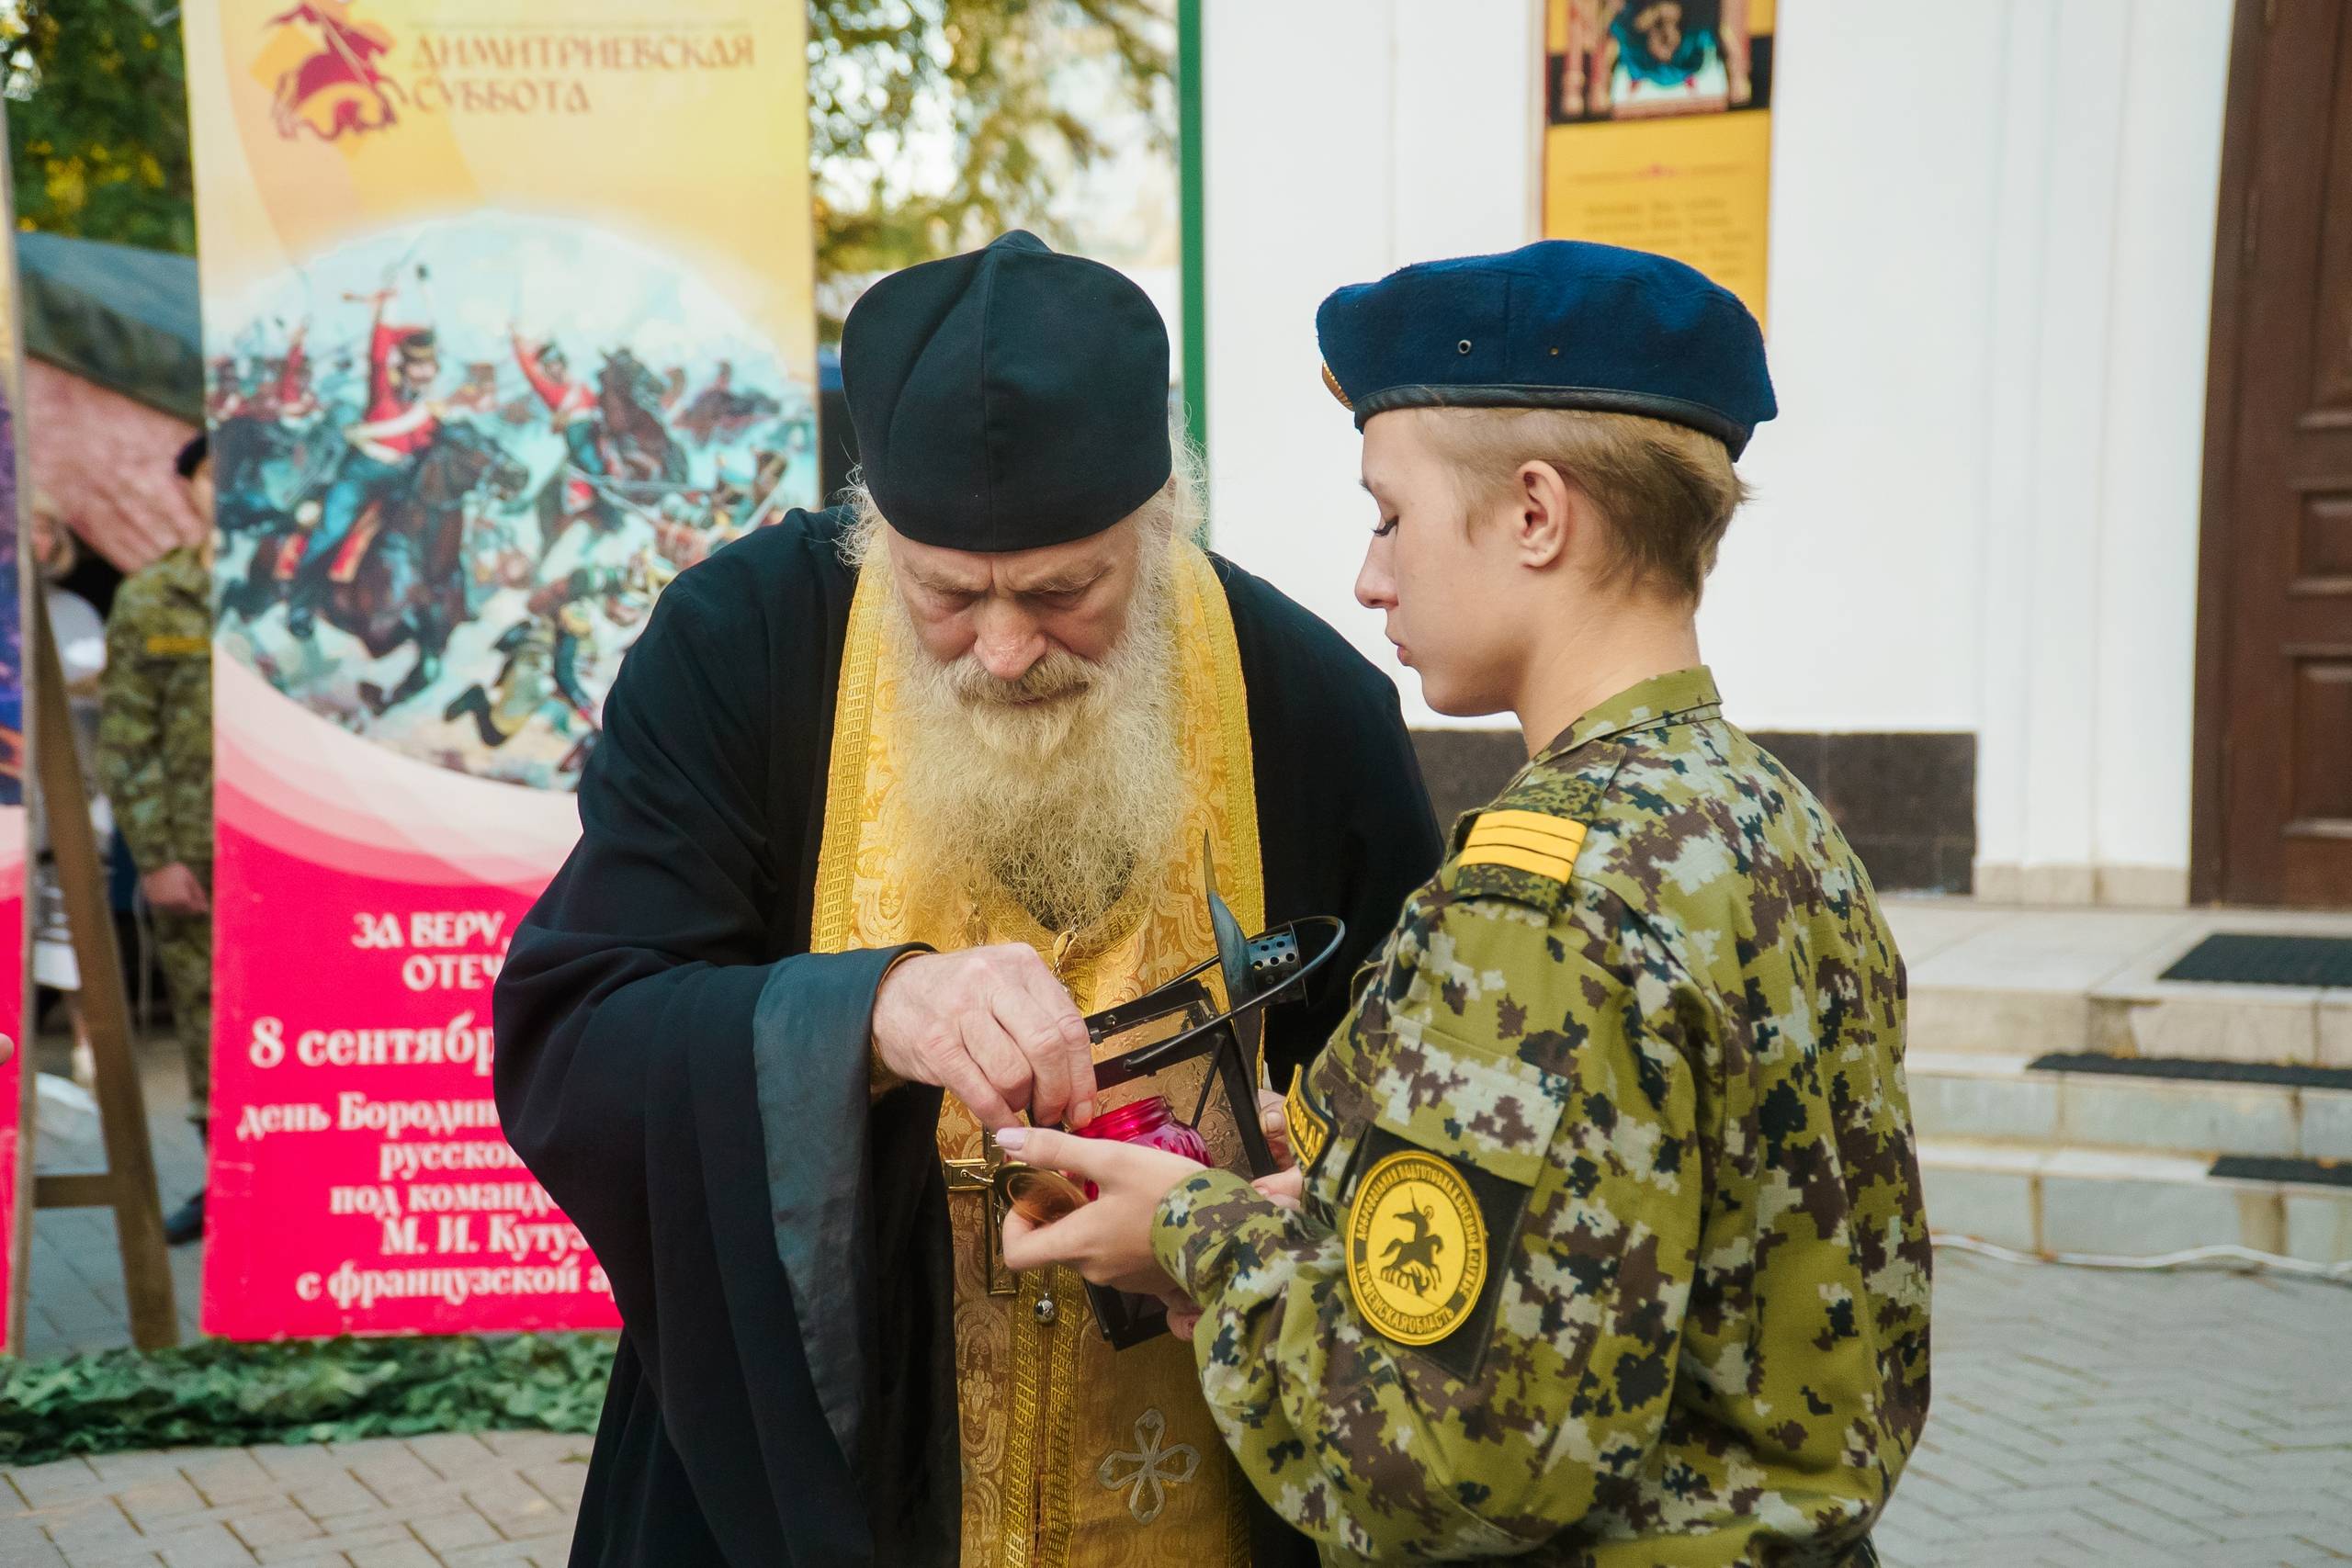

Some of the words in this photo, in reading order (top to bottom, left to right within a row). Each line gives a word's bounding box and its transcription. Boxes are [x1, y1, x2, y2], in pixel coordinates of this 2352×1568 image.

[413, 33, 754, 71] ДИМИТРИЕВСКАЯ
[413, 75, 593, 114] СУББОТА
[351, 911, 404, 949] ЗА
[249, 1016, 285, 1068] 8
[236, 1104, 332, 1141] день
[329, 1186, 401, 1220] под
[381, 1216, 428, 1255] М.
[436, 1215, 481, 1253] И.
[296, 1271, 322, 1301] с
[327, 1253, 582, 1310] французской
[1357, 1261, 1408, 1332] ТЮМЕНСКАЯ
[1408, 1306, 1454, 1334] ОБЛАСТЬ
